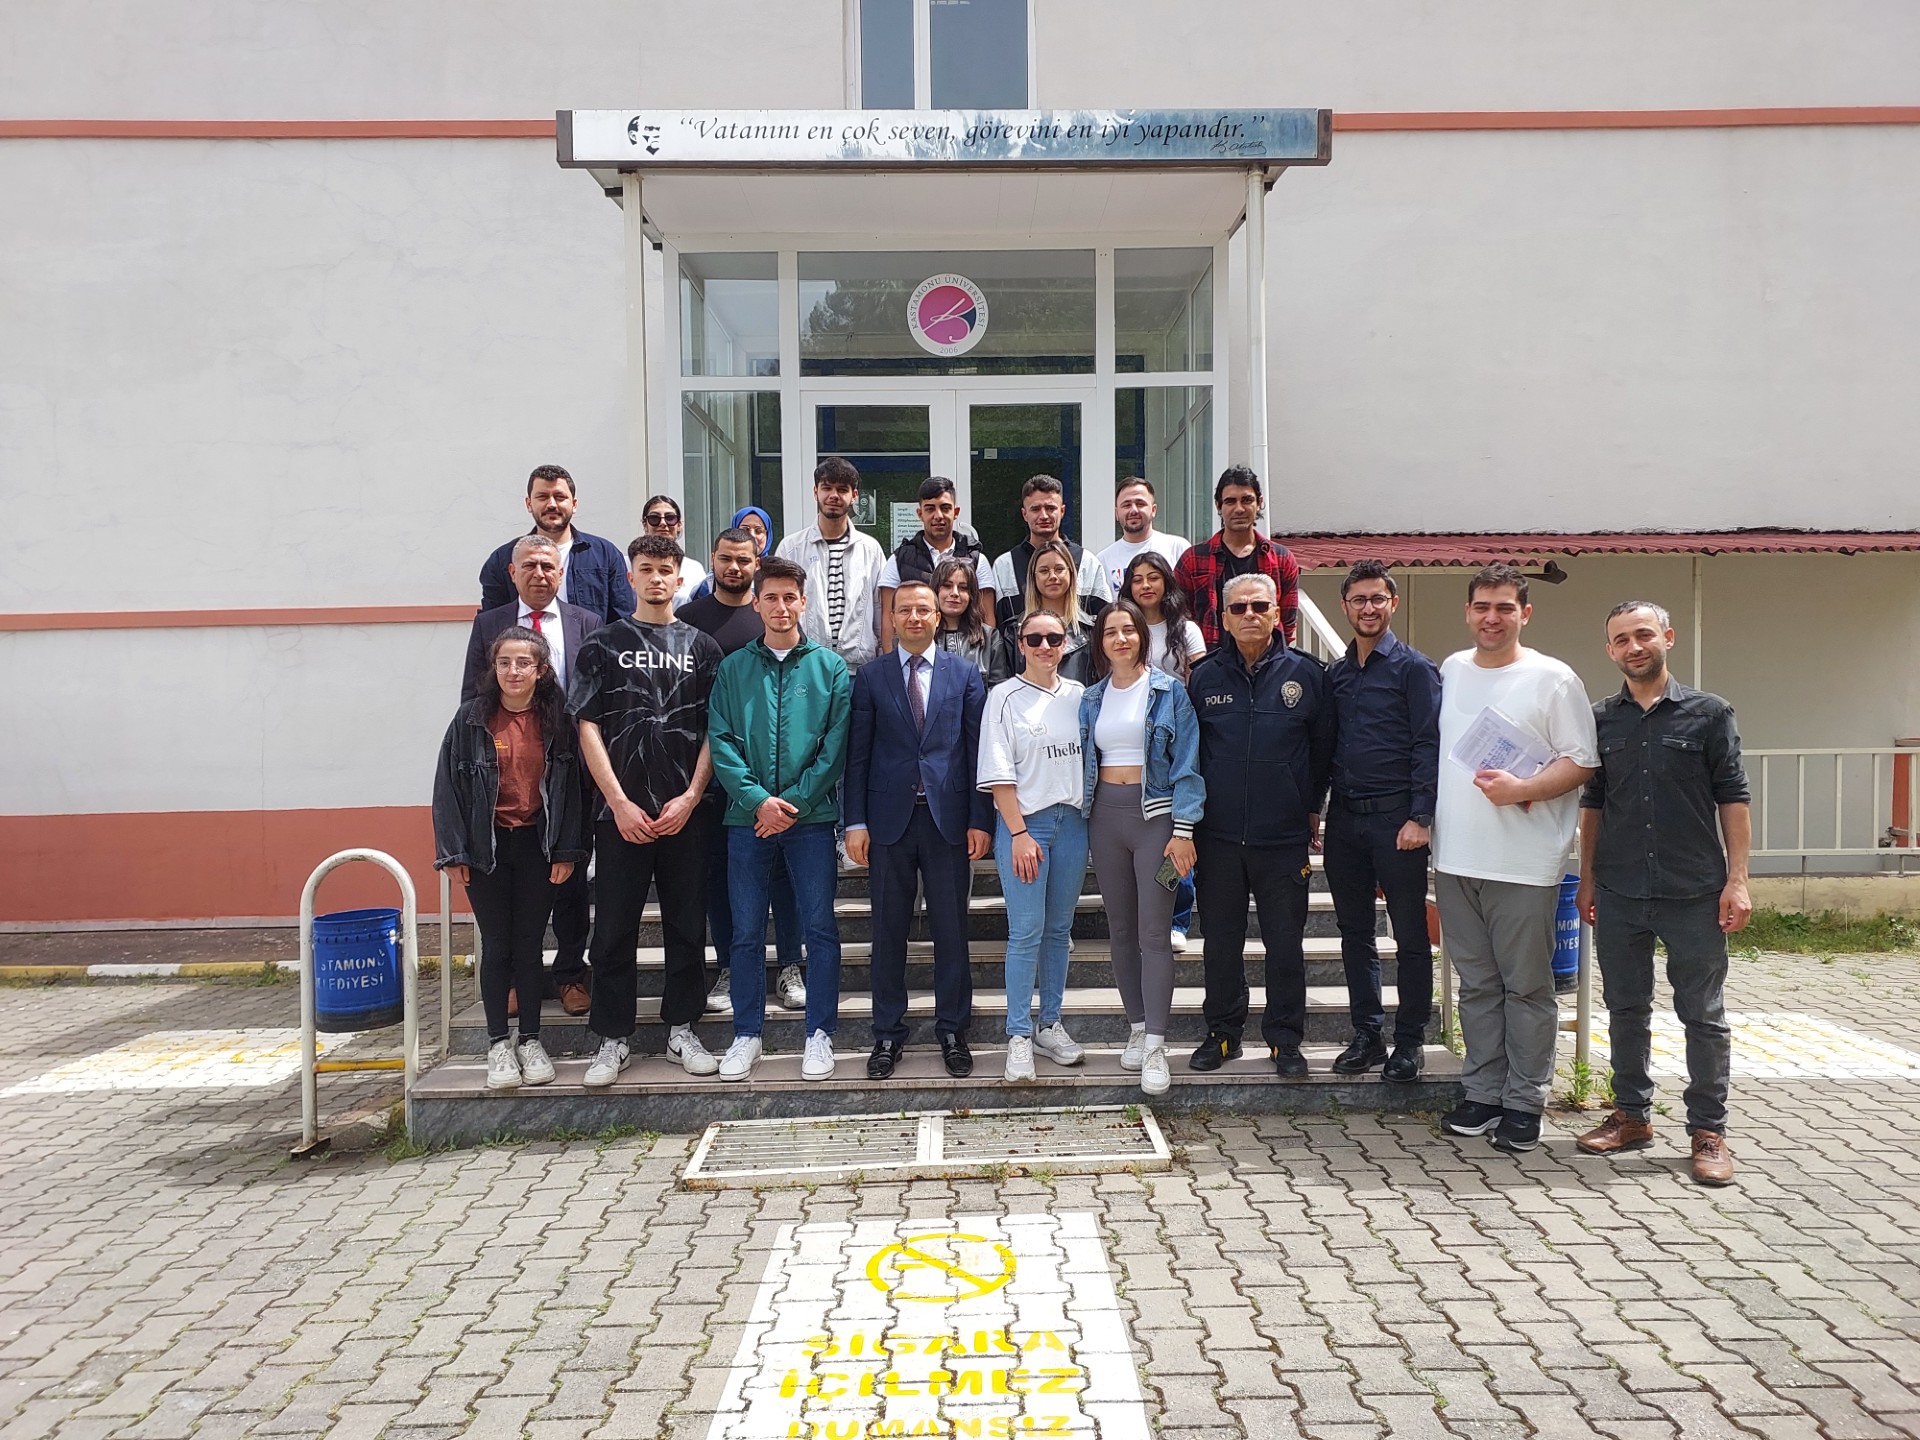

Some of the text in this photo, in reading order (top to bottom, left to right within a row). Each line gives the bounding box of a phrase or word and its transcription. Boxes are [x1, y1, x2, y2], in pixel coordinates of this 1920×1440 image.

[808, 123, 834, 140] en
[841, 117, 886, 147] çok
[888, 121, 956, 145] seven,
[964, 118, 1061, 148] görevini
[1066, 123, 1093, 139] en
[1101, 118, 1130, 147] iyi
[910, 274, 986, 330] KASTAMONU ÜNİVERSİTESİ
[939, 345, 958, 354] 2006
[618, 650, 694, 673] CELINE
